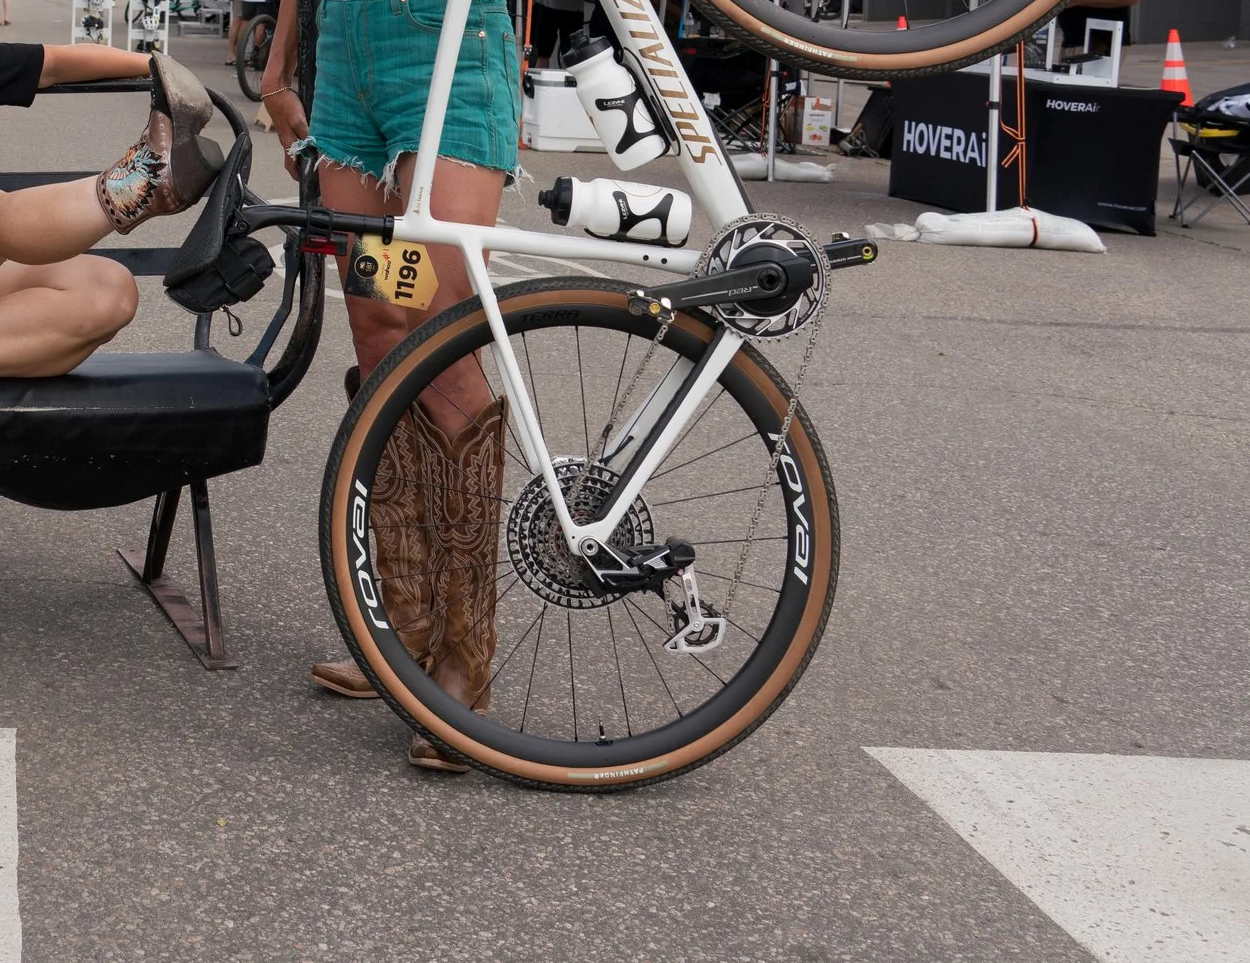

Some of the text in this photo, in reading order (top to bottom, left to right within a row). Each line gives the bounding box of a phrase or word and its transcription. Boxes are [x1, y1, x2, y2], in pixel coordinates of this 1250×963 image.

[784, 38, 833, 58] PATHFINDER
[902, 119, 988, 168] HOVERAi
[394, 248, 422, 300] 1196
[351, 479, 389, 630] roval
[593, 767, 645, 780] PATHFINDER
